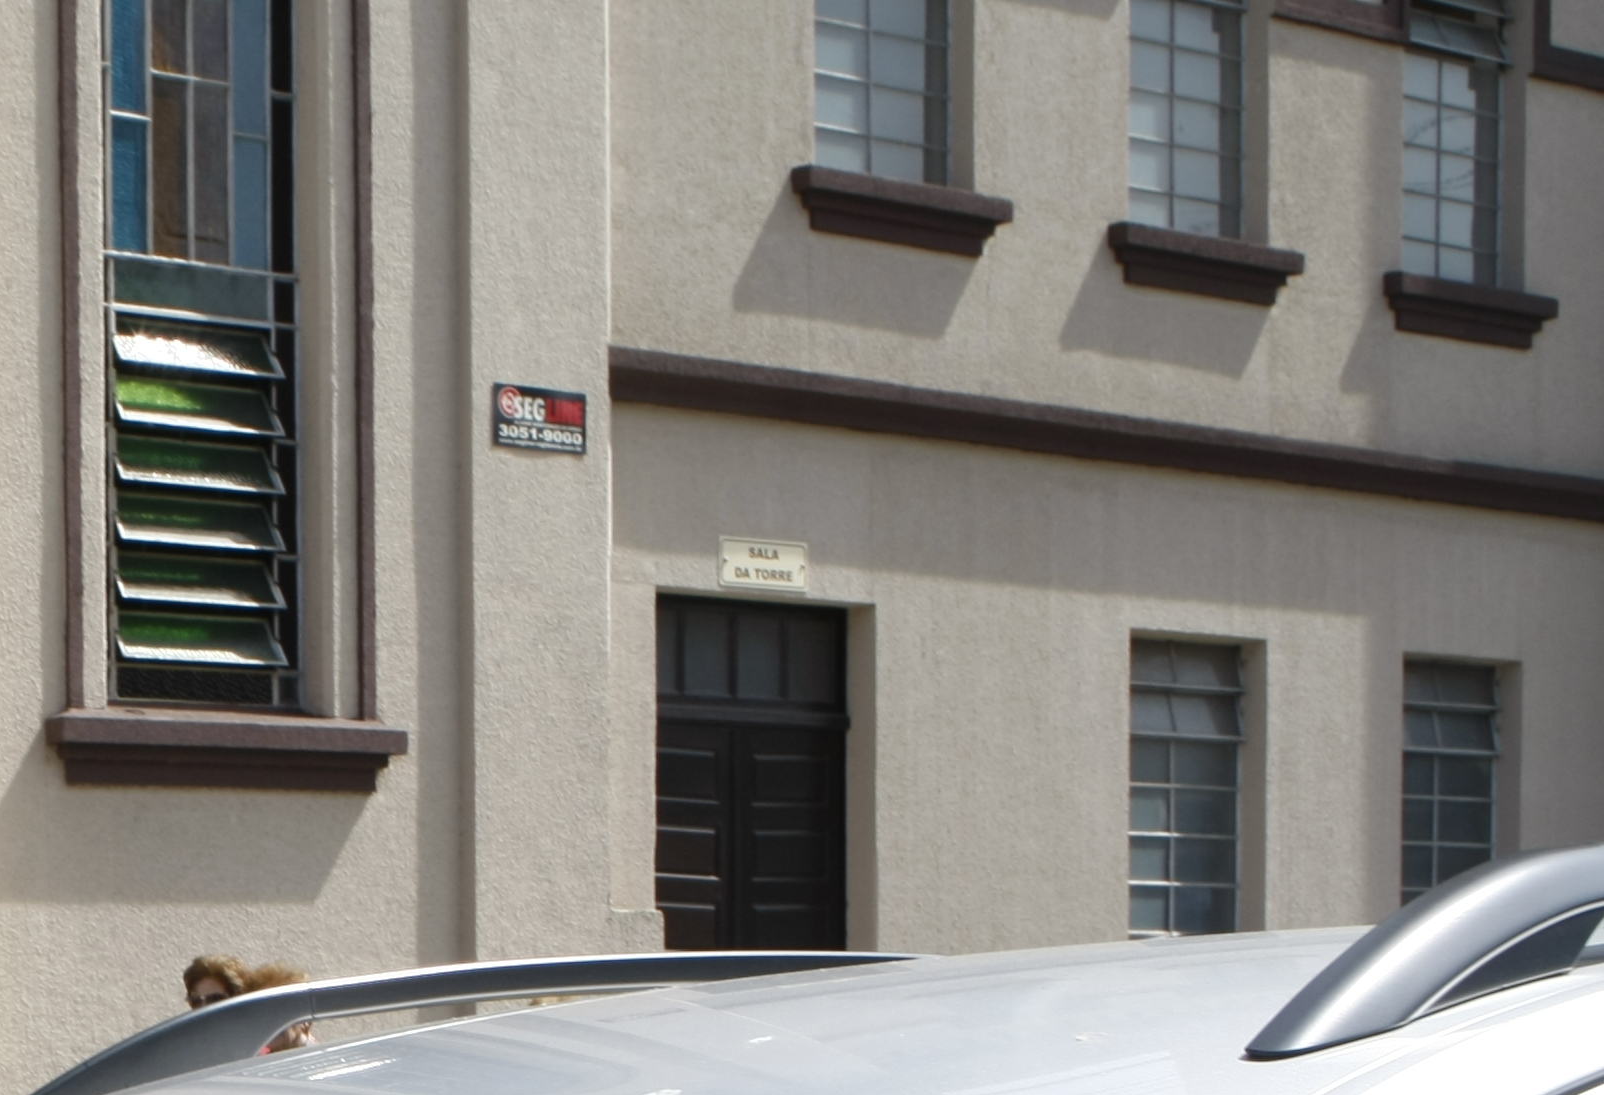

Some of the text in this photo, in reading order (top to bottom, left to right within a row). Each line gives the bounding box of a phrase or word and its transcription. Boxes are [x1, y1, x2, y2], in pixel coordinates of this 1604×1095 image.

[498, 423, 583, 446] 3051-9000
[748, 547, 780, 560] SALA
[734, 566, 793, 582] DA TORRE
